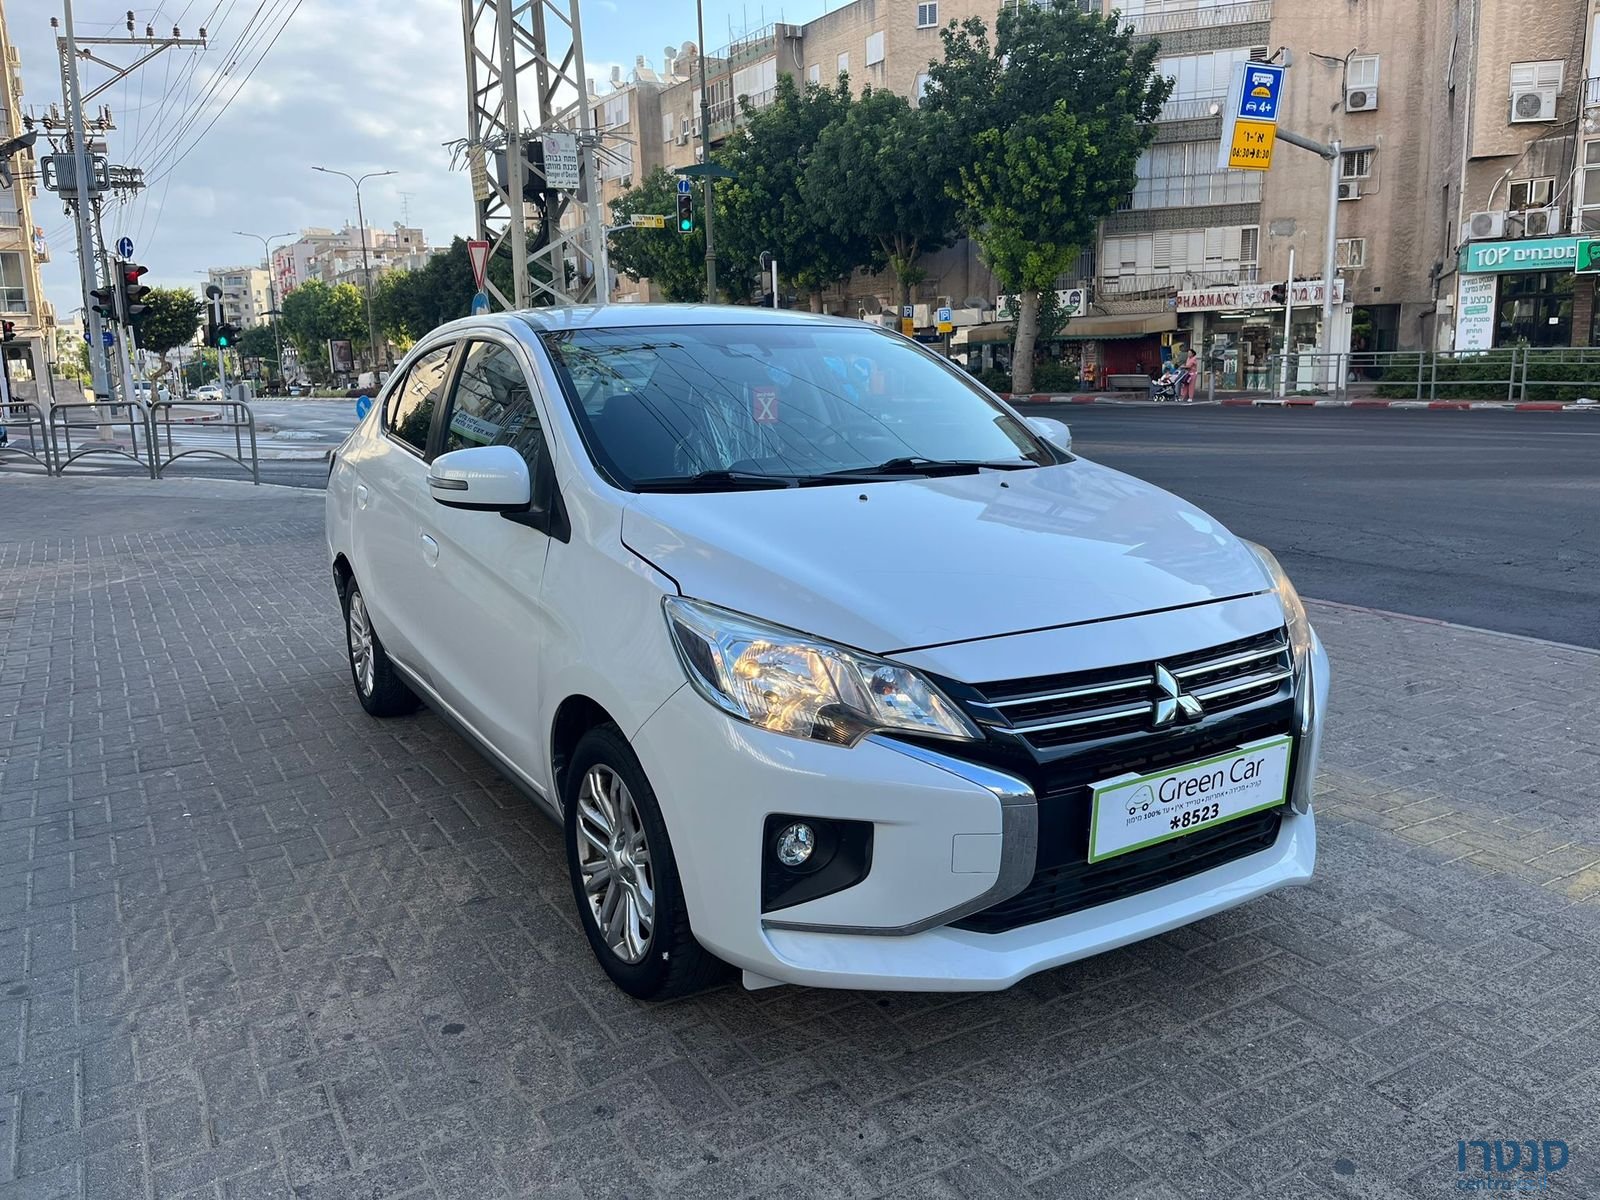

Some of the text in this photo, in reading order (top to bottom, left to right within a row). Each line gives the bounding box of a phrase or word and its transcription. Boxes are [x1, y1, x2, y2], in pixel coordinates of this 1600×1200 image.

[563, 163, 578, 171] סכנת
[546, 170, 560, 178] Danger
[1474, 246, 1576, 267] מטבחים TOP
[1176, 291, 1239, 308] PHARMACY
[1470, 295, 1493, 305] מבצע
[1158, 757, 1265, 803] Green Car
[1204, 791, 1225, 802] אחריות
[1126, 814, 1143, 826] מימון
[1143, 810, 1162, 820] 100%
